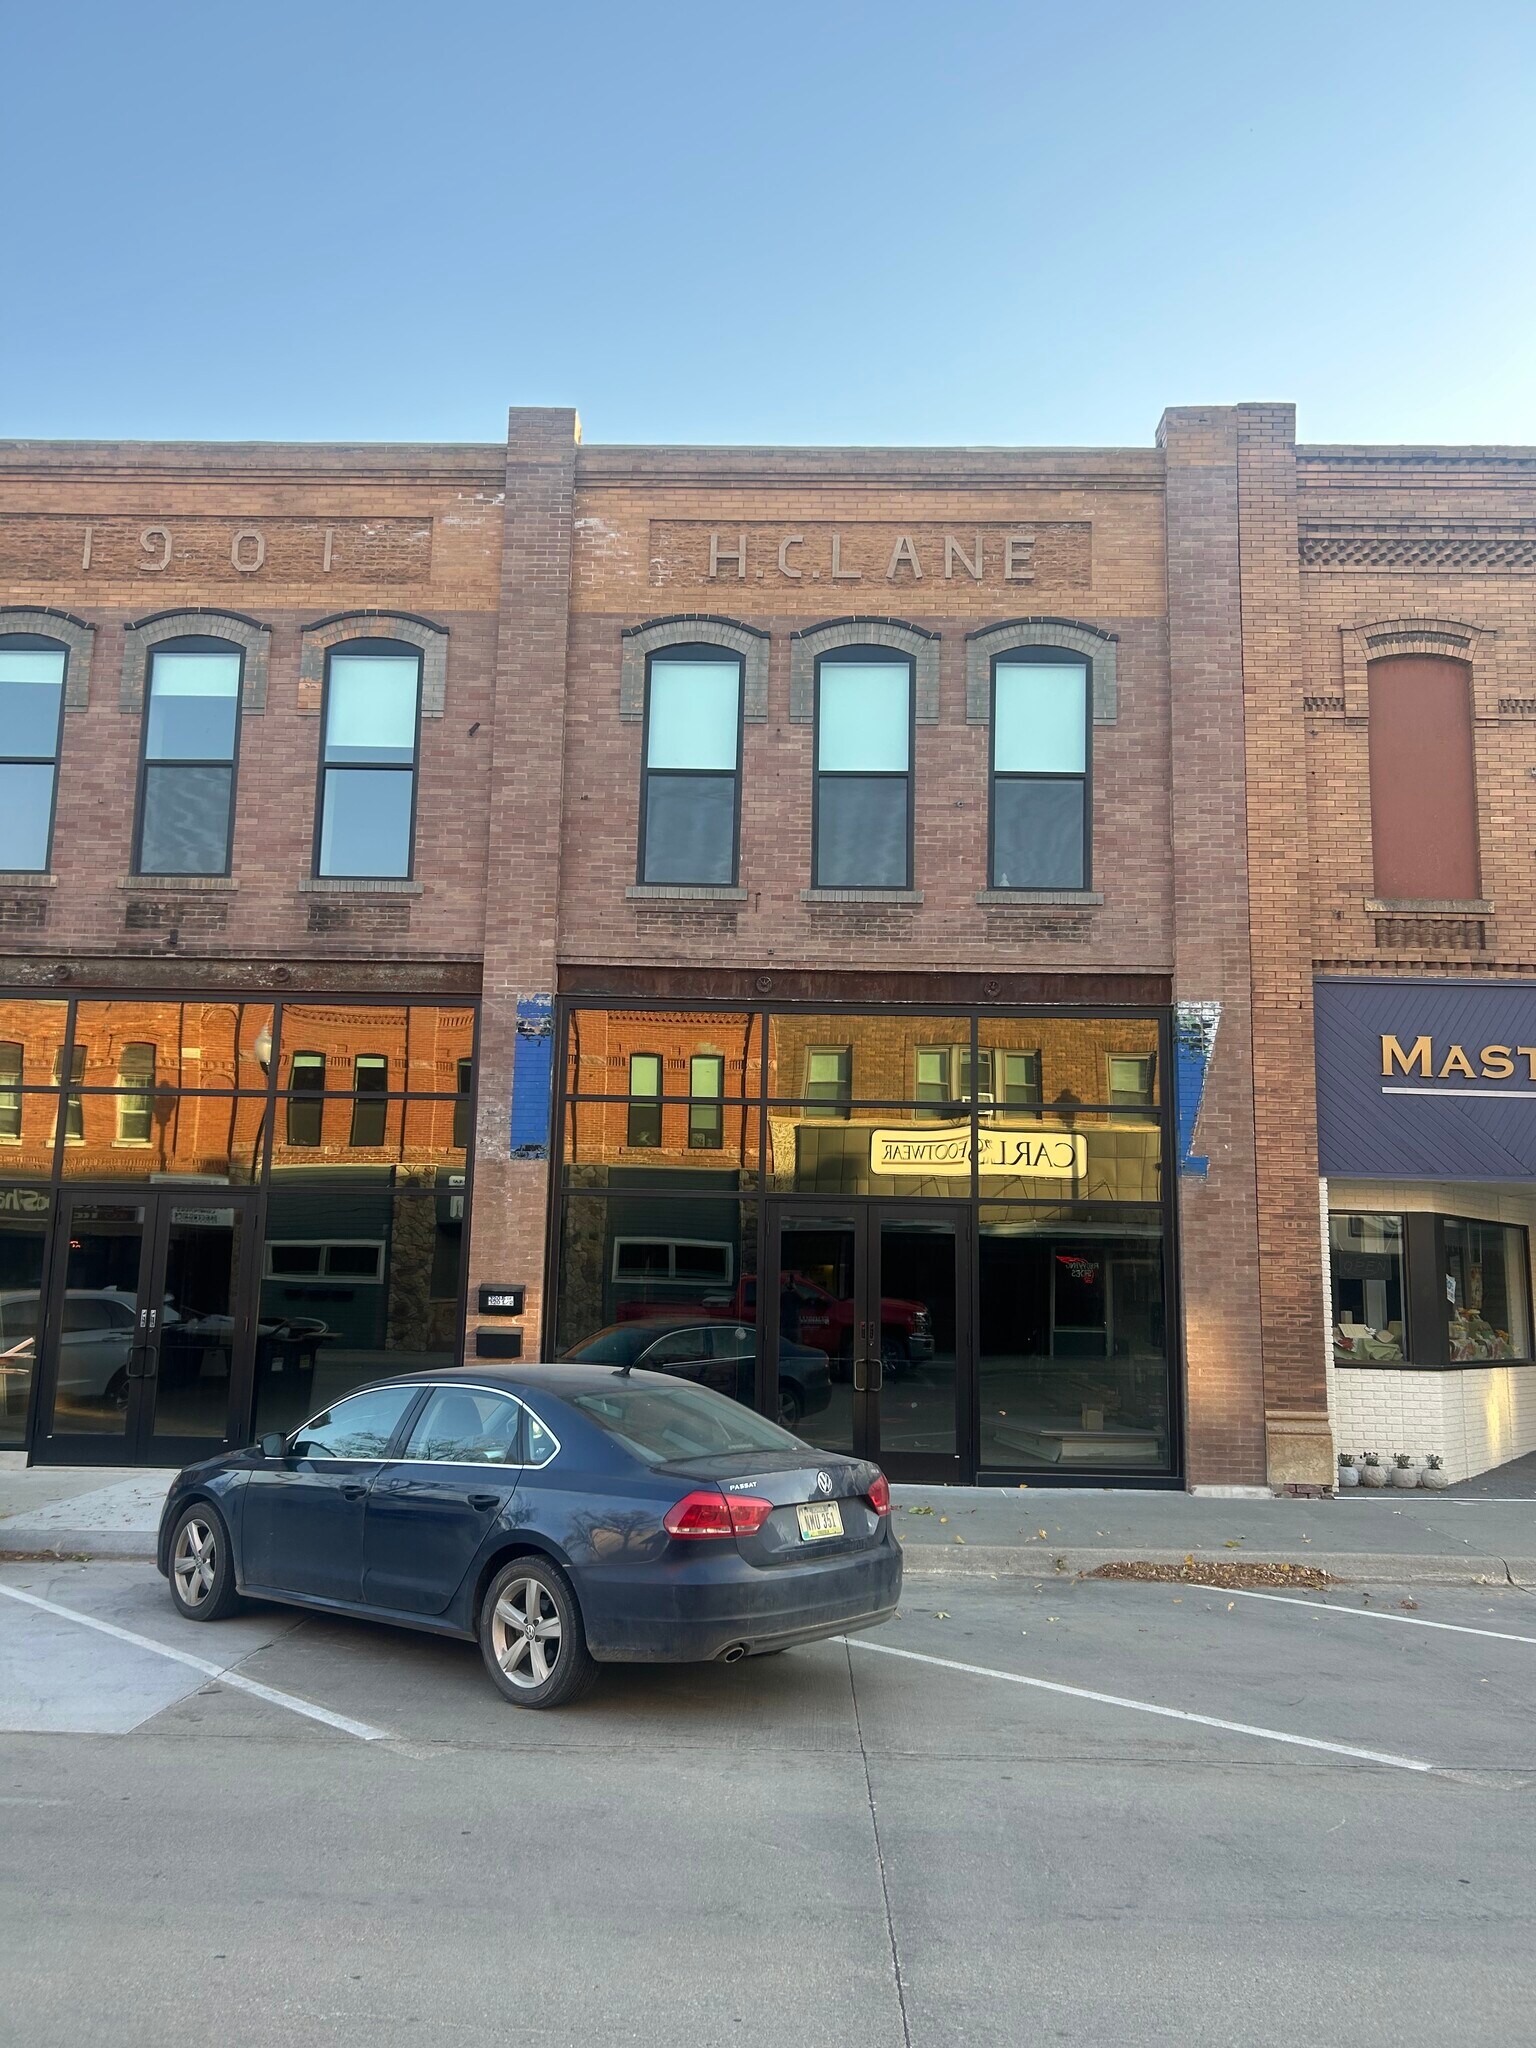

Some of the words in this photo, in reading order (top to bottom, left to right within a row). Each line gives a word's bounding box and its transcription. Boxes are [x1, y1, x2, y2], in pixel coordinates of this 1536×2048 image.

[82, 526, 333, 572] 1901
[729, 1481, 757, 1491] PASSAT
[804, 1513, 821, 1531] NMU
[821, 1512, 837, 1529] 351
